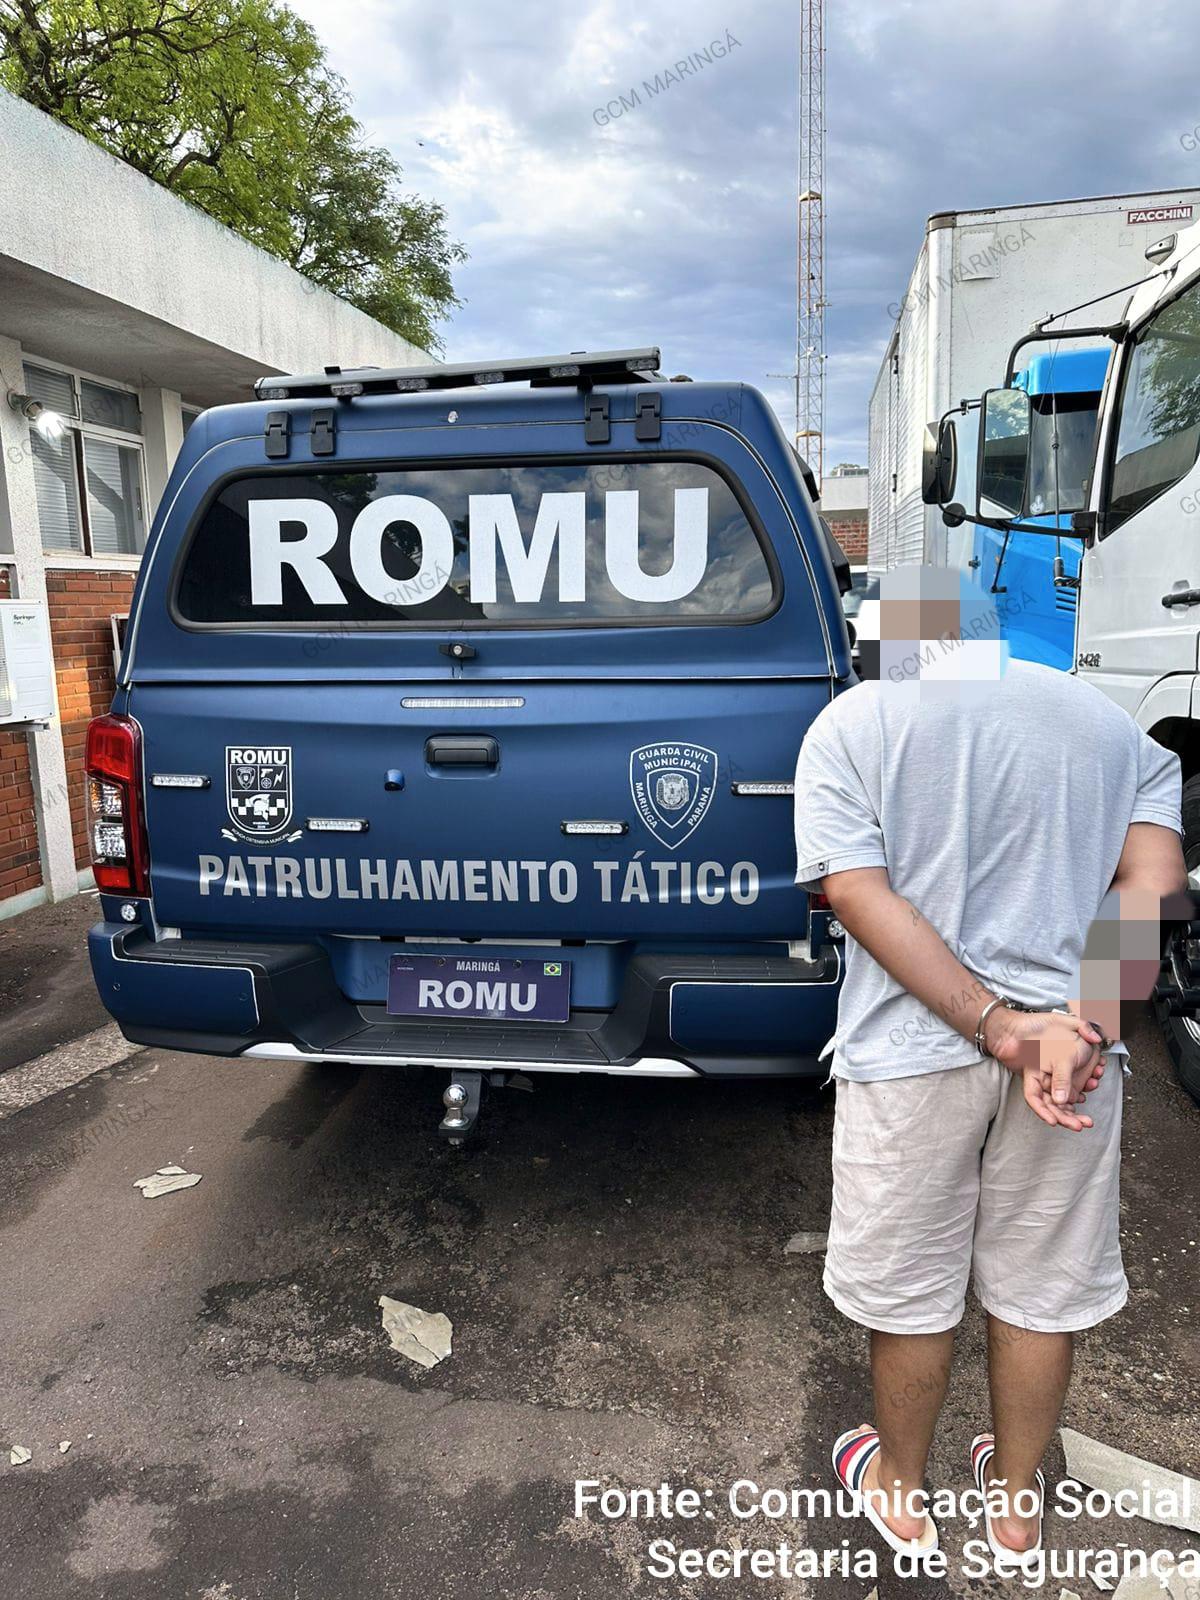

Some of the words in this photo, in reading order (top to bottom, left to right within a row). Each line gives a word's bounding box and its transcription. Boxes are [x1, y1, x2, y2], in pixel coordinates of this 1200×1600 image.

[1129, 207, 1191, 222] FACCHINI
[248, 488, 709, 606] ROMU
[230, 750, 287, 764] ROMU
[638, 747, 681, 761] GUARDA
[684, 749, 709, 764] CIVIL
[644, 757, 702, 773] MUNICIPAL
[198, 854, 579, 904] PATRULHAMENTO
[593, 851, 760, 905] TÁTICO
[456, 959, 501, 973] MARINGÁ
[418, 979, 537, 1012] ROMU
